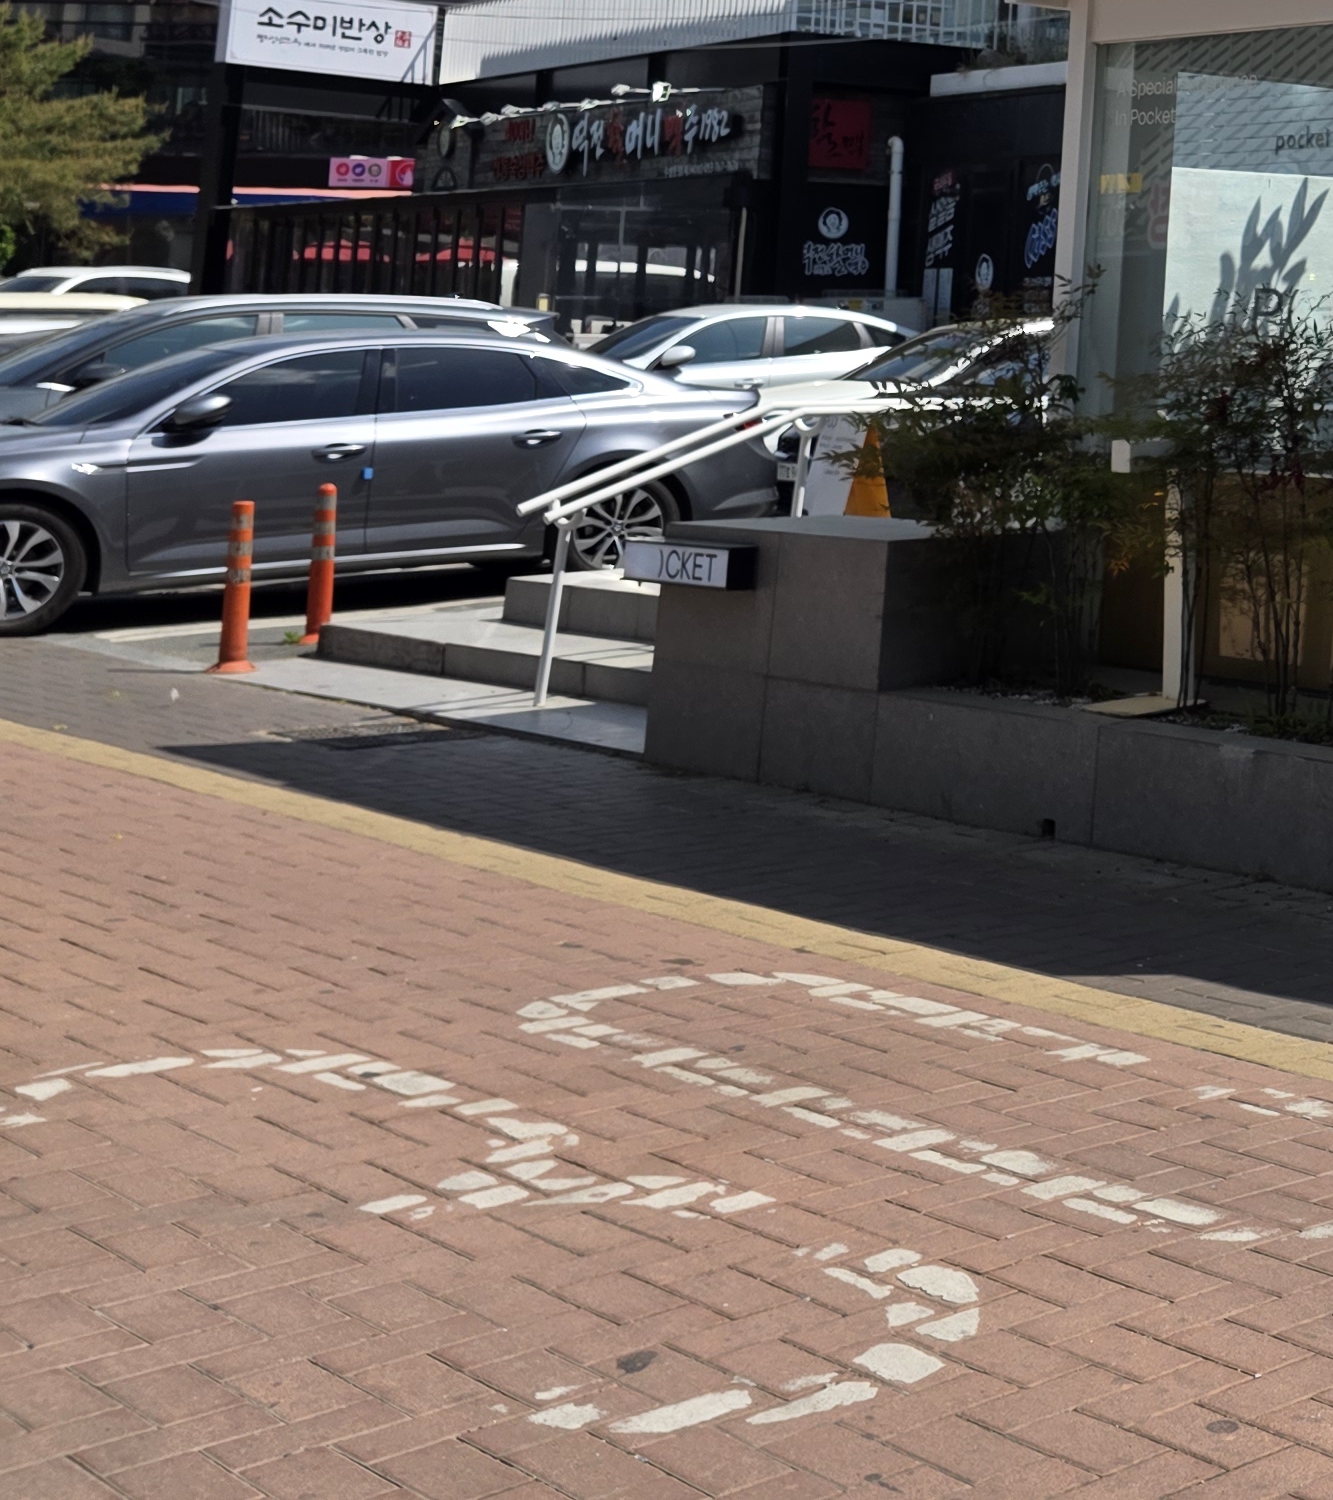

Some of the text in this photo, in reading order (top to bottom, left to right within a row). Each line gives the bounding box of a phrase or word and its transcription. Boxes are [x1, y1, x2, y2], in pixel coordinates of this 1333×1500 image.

[256, 6, 393, 45] 소수미반상
[1130, 77, 1178, 100] Special
[1114, 105, 1178, 127] In Pocket
[1274, 124, 1331, 156] pocket
